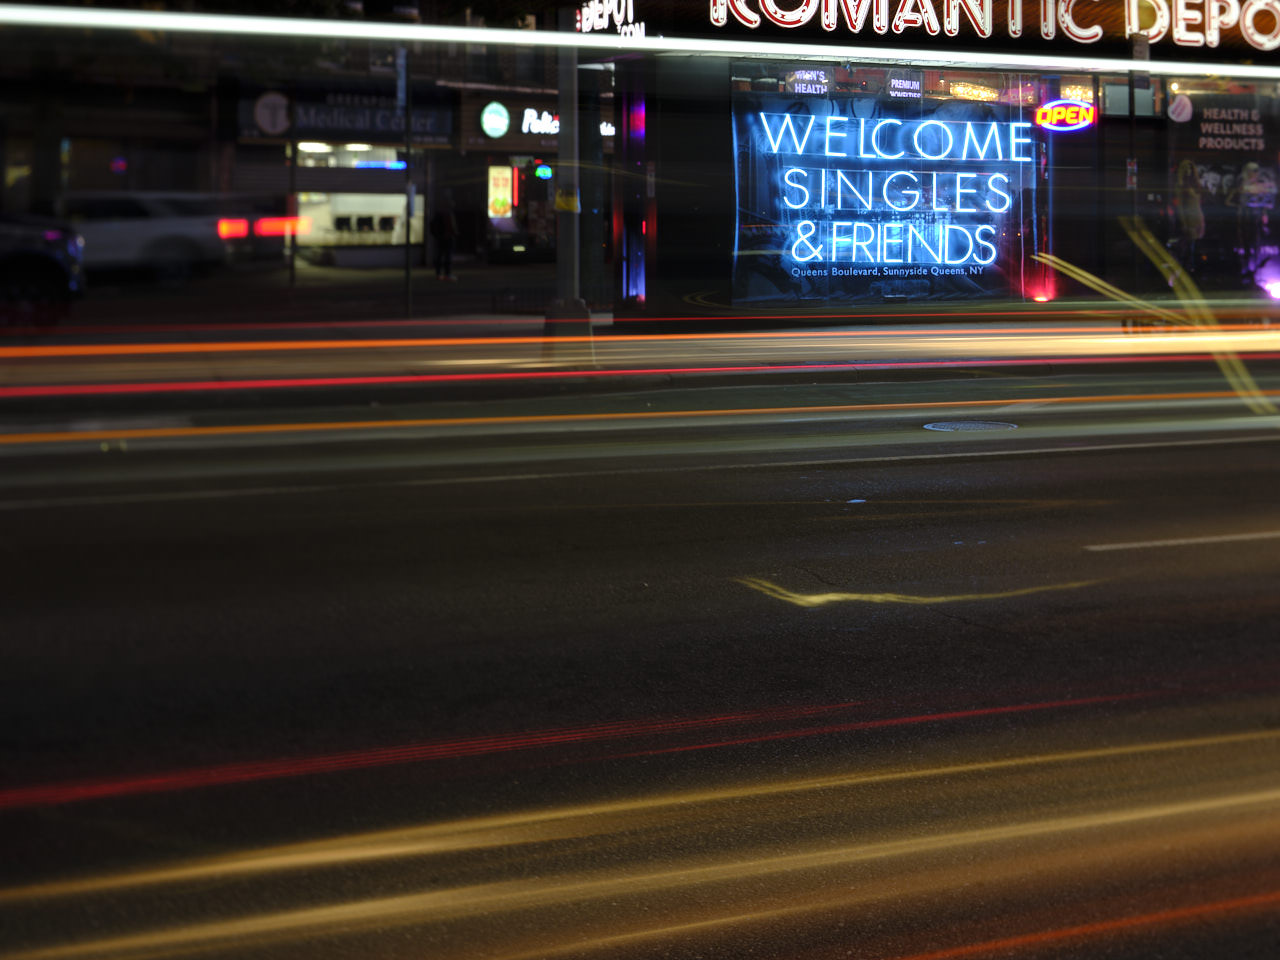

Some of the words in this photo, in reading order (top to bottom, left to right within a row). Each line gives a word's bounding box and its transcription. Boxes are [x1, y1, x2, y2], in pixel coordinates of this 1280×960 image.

[794, 83, 828, 94] HEALTH
[891, 78, 920, 90] PREMIUM
[1035, 106, 1095, 126] OPEN
[1203, 108, 1248, 121] HEALTH
[1200, 122, 1264, 136] WELLNESS
[759, 112, 1033, 162] WELCOME
[1199, 136, 1265, 150] PRODUCTS
[783, 168, 1011, 213] SINGLES
[791, 267, 828, 277] Queens
[832, 266, 880, 277] Boulevard,
[883, 266, 927, 278] Sunnyside
[931, 266, 967, 277] Queens,
[969, 266, 984, 276] NY
